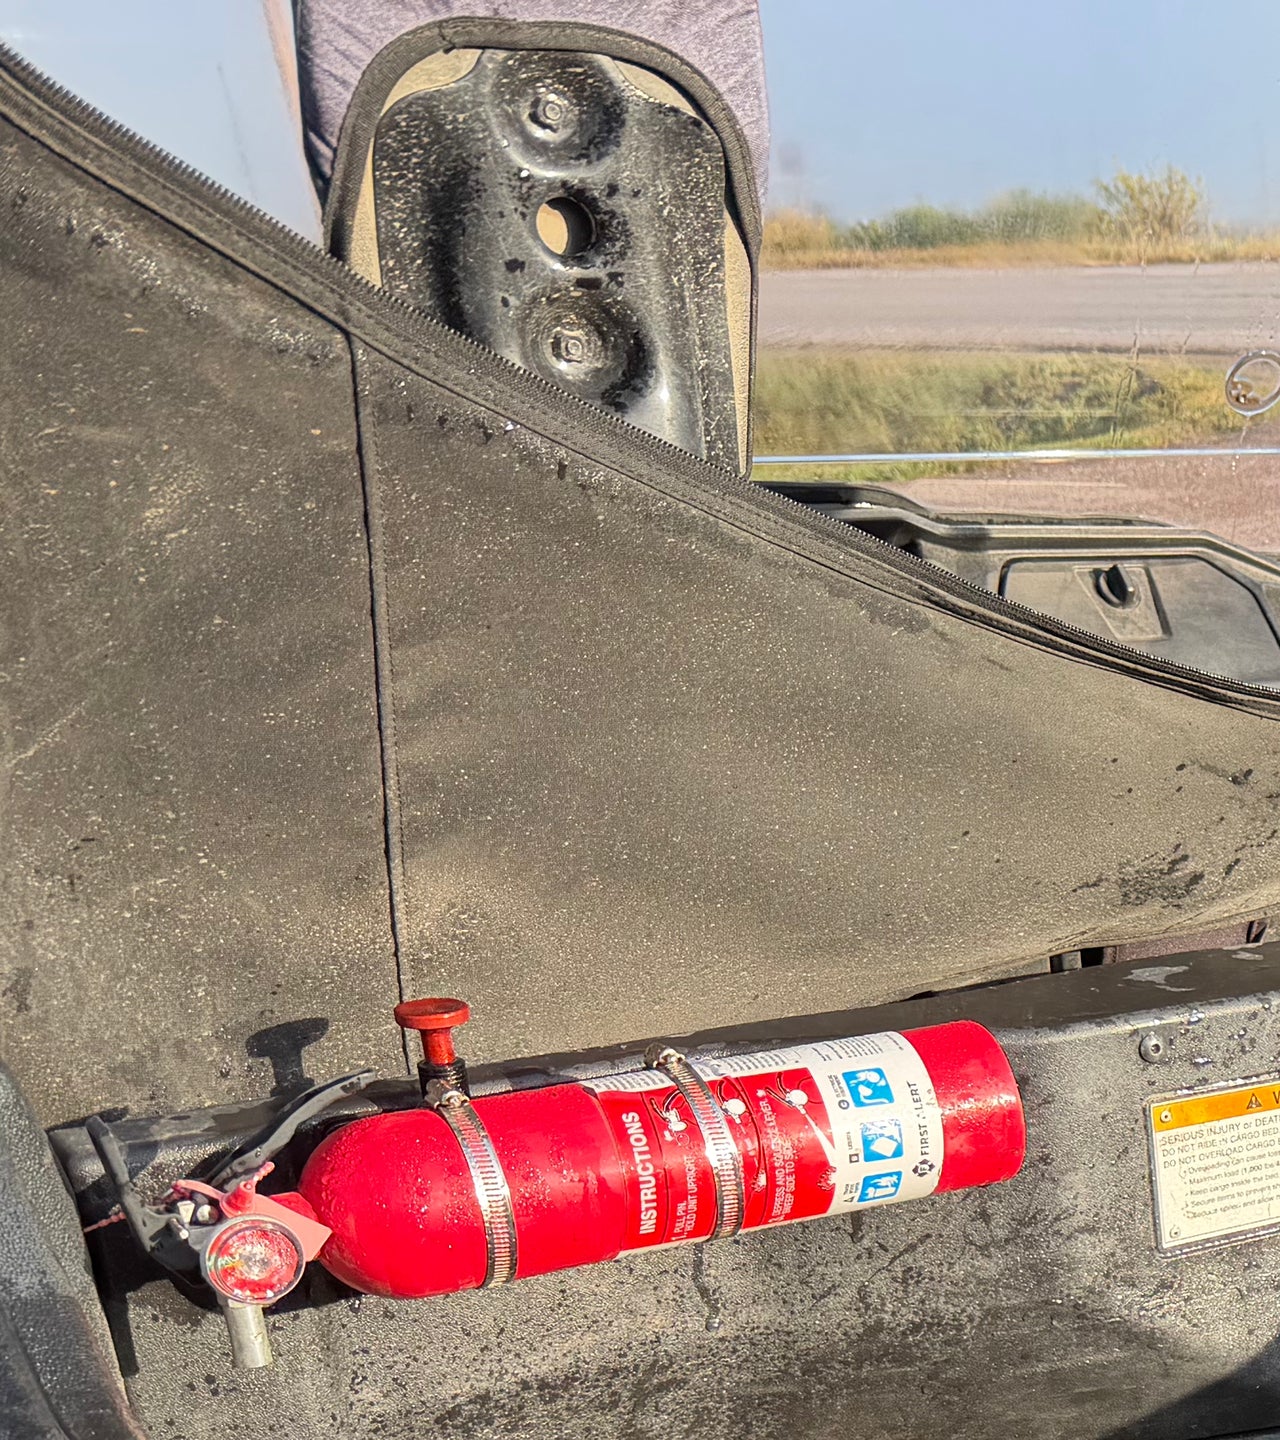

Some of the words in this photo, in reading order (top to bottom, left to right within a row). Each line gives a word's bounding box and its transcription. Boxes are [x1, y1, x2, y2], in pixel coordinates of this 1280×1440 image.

[906, 1081, 926, 1120] LERT
[918, 1124, 930, 1156] FIRST
[1160, 1130, 1204, 1146] SERIOUS
[1207, 1123, 1240, 1136] INJURY
[1244, 1122, 1252, 1130] or
[1162, 1148, 1175, 1158] DO
[1178, 1144, 1195, 1154] NOT
[1198, 1139, 1218, 1150] RIDE
[1230, 1131, 1260, 1144] CARGO
[1164, 1160, 1176, 1168] DO
[1179, 1154, 1196, 1166] NOT
[1198, 1146, 1244, 1160] OVERLOAD
[1246, 1139, 1276, 1152] CARGO
[631, 1111, 657, 1234] INSTRUCTIONS
[776, 1169, 786, 1187] AND
[786, 1160, 794, 1174] TO
[786, 1174, 796, 1194] SIDE
[688, 1195, 698, 1212] UNIT
[772, 1187, 785, 1217] DEPRESS
[674, 1214, 686, 1233] PULL
